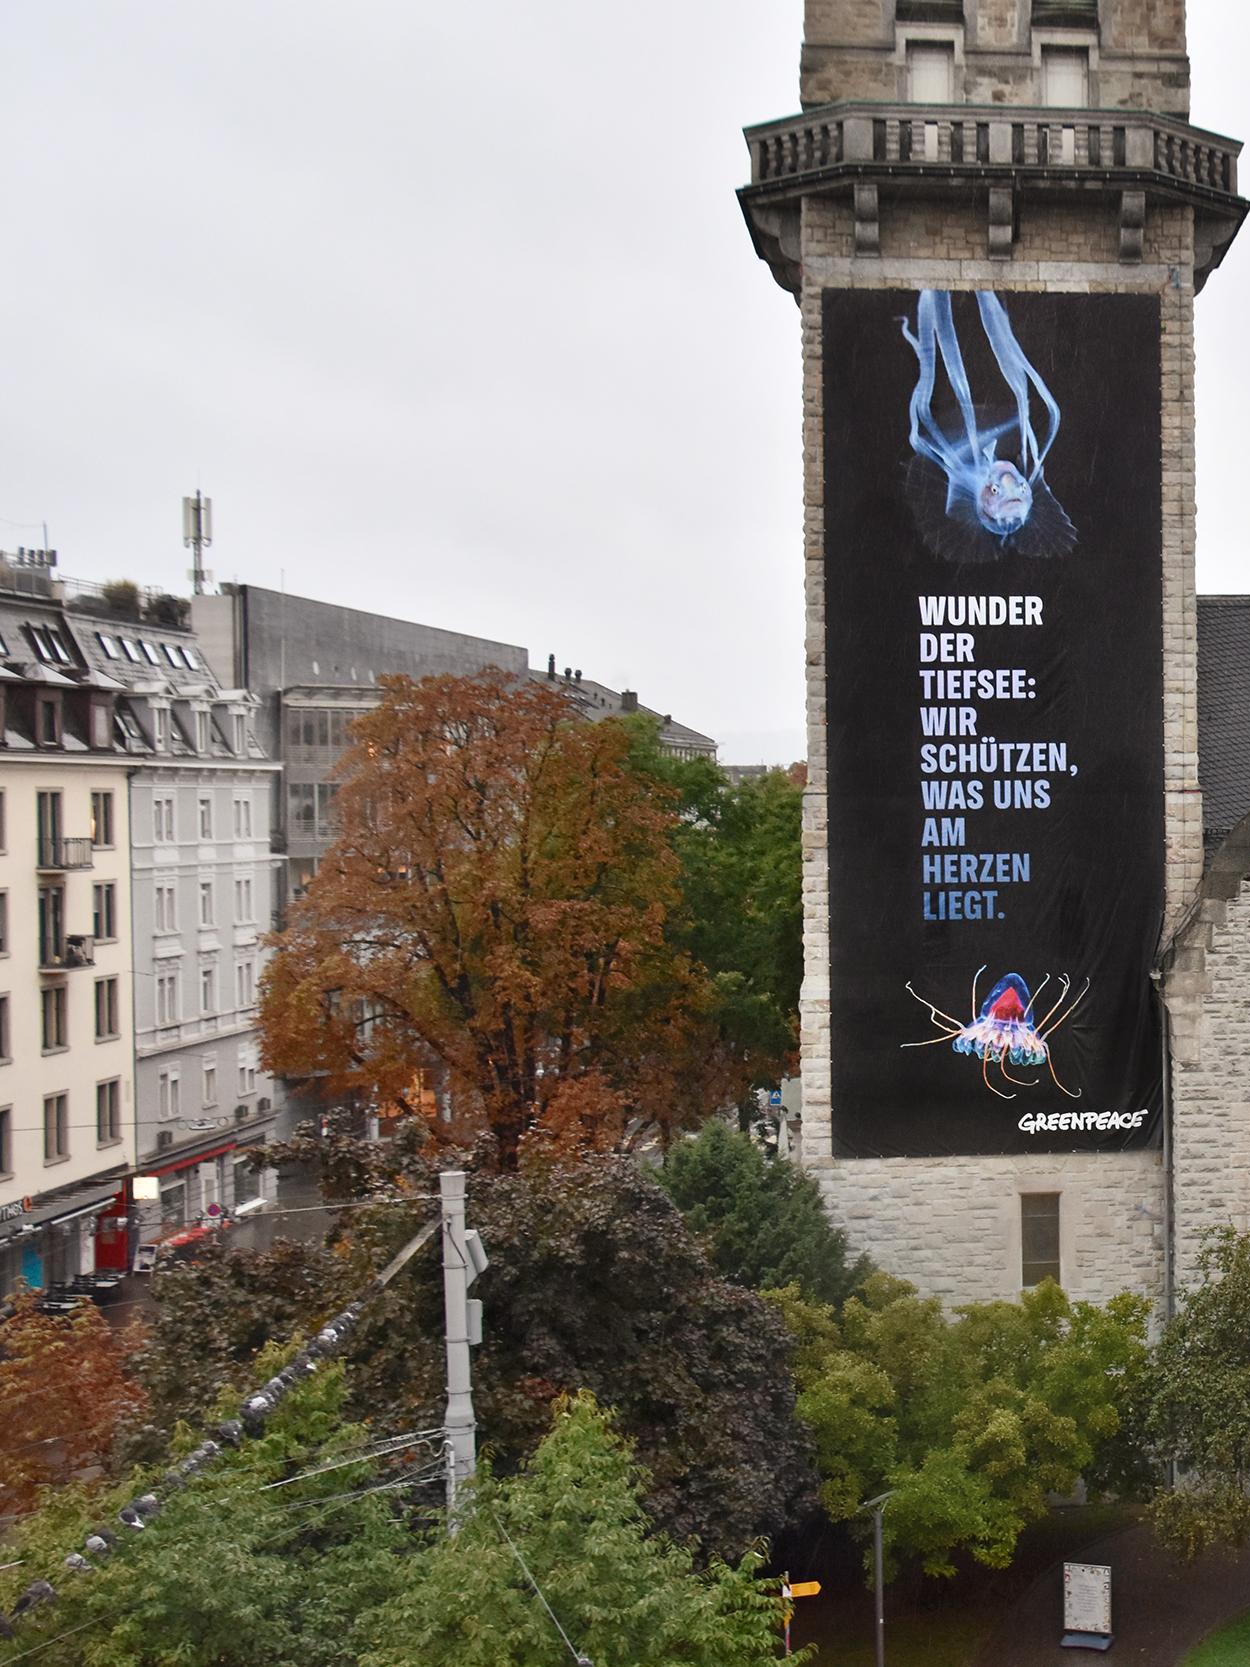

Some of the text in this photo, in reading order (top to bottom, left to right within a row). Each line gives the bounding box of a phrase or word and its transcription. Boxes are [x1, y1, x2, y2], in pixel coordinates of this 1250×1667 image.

[918, 595, 1044, 626] WUNDER
[919, 632, 975, 663] DER
[918, 669, 1037, 700] TIEFSEE:
[919, 706, 978, 737] WIR
[920, 736, 1079, 777] SCHÜTZEN,
[920, 779, 1052, 811] WAS UNS
[921, 817, 966, 847] AM
[922, 853, 1031, 884] HERZEN
[923, 889, 1006, 921] LIEGT.
[1017, 1108, 1150, 1135] GREENPEACE
